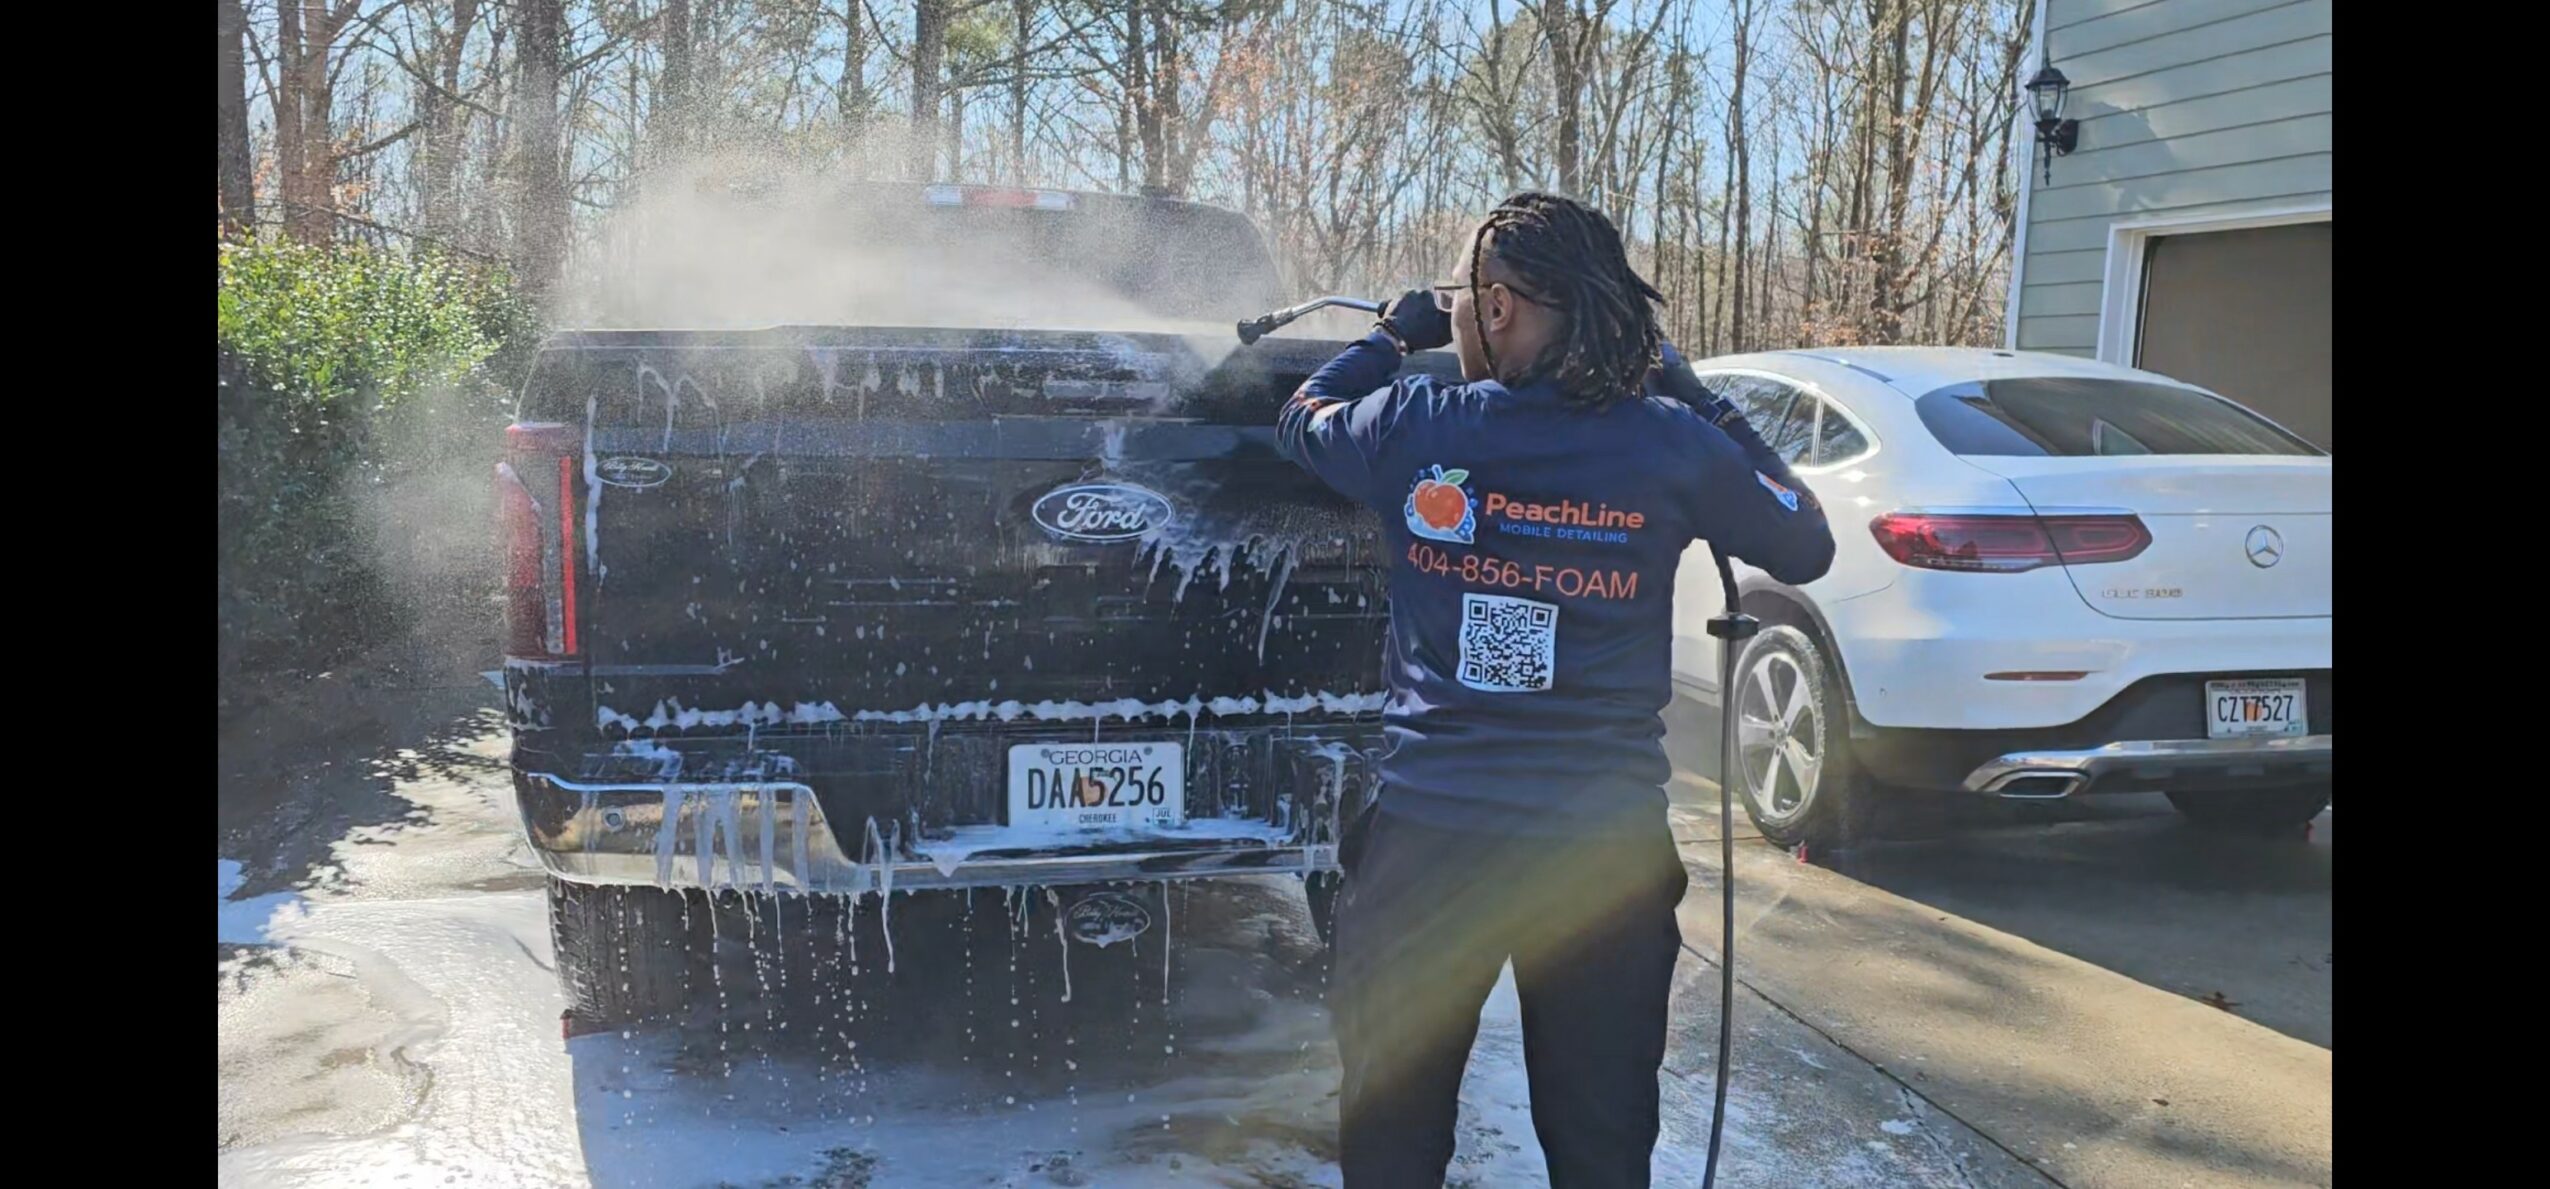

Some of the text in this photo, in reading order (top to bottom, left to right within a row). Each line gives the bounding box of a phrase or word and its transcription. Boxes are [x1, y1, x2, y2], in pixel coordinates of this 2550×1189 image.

[1057, 492, 1146, 531] Ford
[1486, 493, 1644, 529] PeachLine
[1500, 523, 1628, 543] MOBILE DETAILING
[1408, 542, 1638, 599] 404-856-FOAM
[2218, 694, 2293, 722] CZT7527
[1049, 749, 1143, 765] GEORGIA
[1028, 766, 1165, 809] DAA5256
[1079, 813, 1117, 824] CHEROKEE
